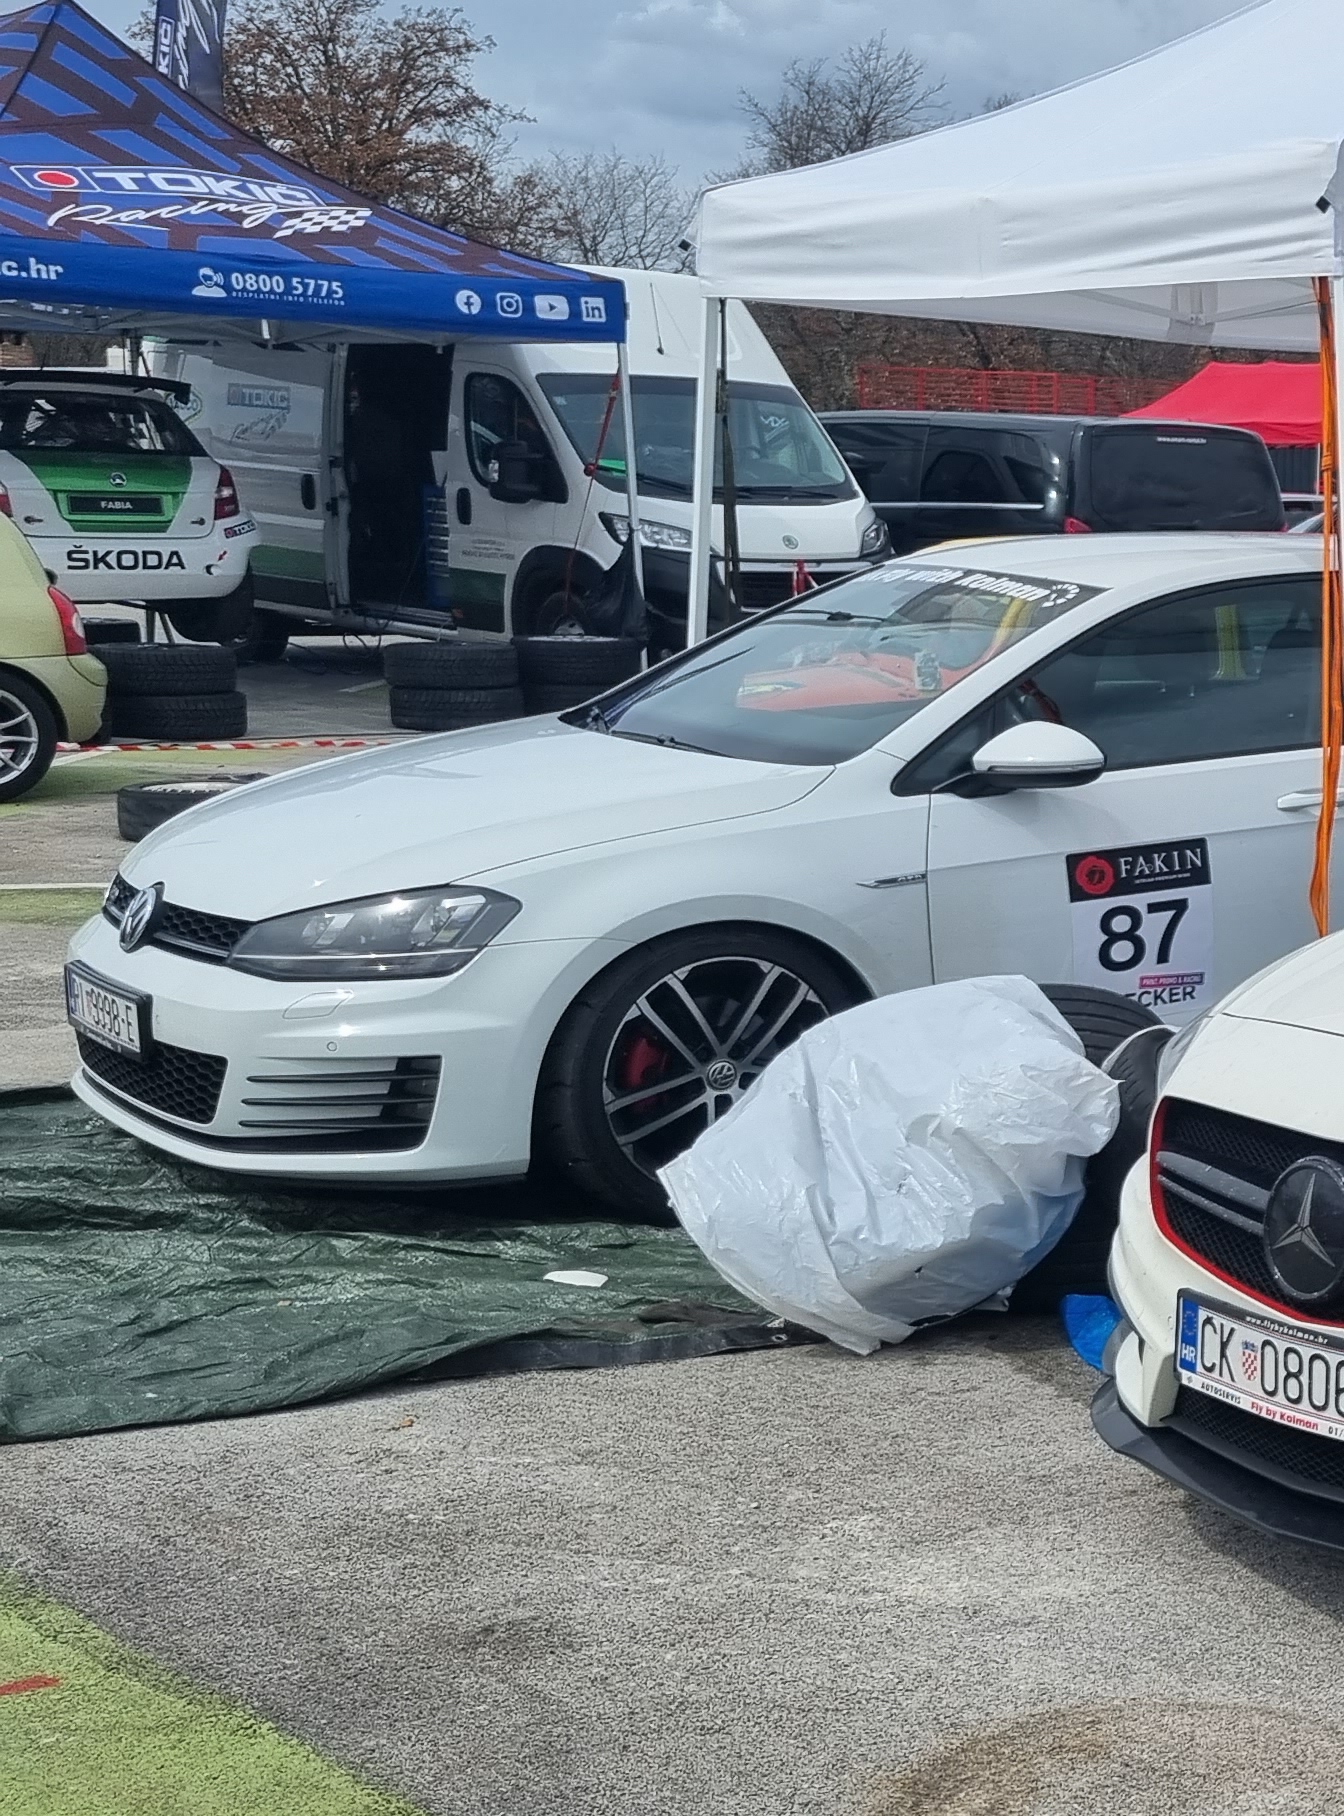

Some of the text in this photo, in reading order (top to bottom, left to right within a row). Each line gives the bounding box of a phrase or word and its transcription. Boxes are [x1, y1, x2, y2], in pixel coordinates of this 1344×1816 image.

[93, 171, 312, 207] TOKIĆ
[47, 200, 283, 231] Racing
[0, 257, 64, 280] c.hr
[231, 272, 344, 298] 0800 5775
[100, 501, 132, 510] FABIA
[66, 544, 186, 571] ŠKODA
[954, 573, 1051, 601] Kolman
[1119, 847, 1203, 878] FAKIN
[1098, 897, 1190, 973] 87
[1125, 985, 1197, 1008] CKER
[1181, 1345, 1196, 1364] HR
[1200, 1315, 1237, 1383] ČK
[1201, 1382, 1242, 1405] AUTOSERVIS
[1250, 1402, 1265, 1416] Fly
[1266, 1405, 1278, 1420] by
[1279, 1409, 1319, 1430] Kolman
